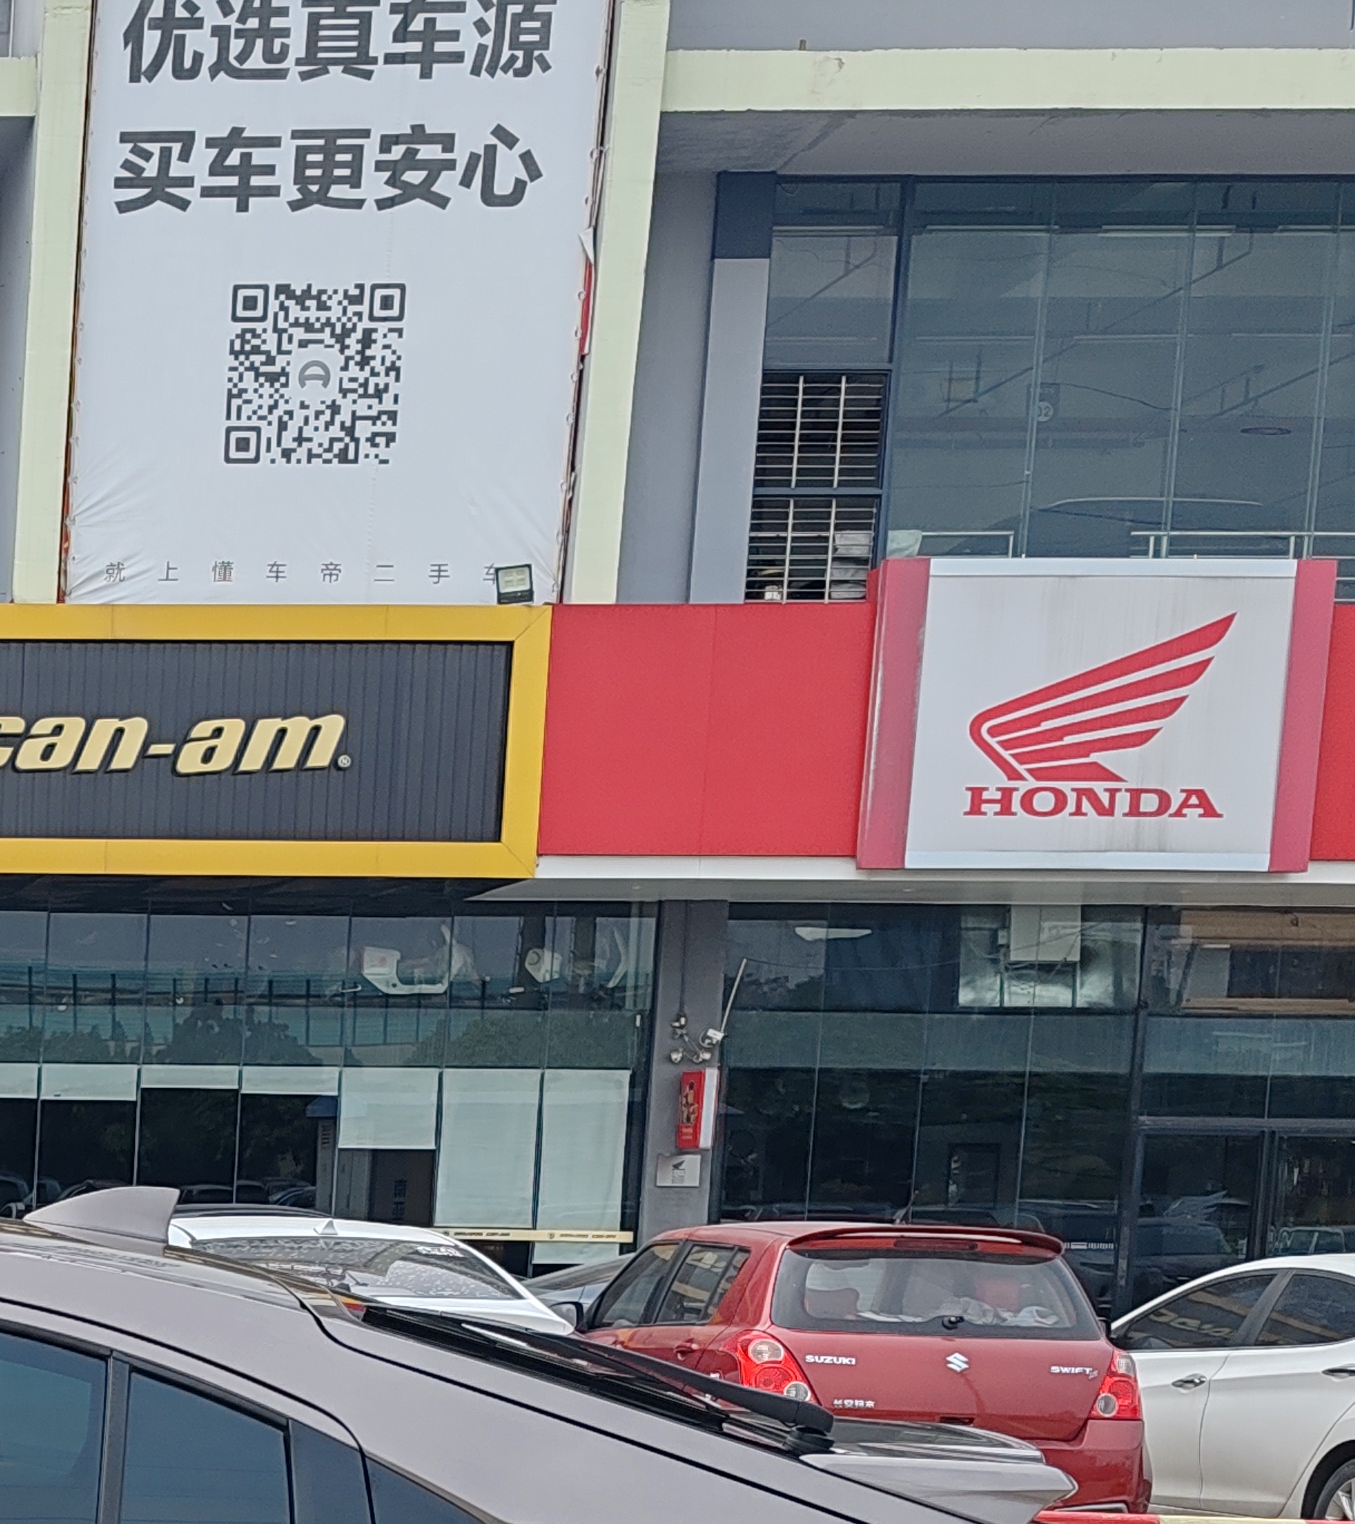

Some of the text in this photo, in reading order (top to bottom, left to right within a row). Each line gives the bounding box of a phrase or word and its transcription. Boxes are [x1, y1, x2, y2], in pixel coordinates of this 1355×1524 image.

[123, 0, 555, 83] 优选真车源
[114, 123, 543, 214] 买车更安心
[962, 786, 1225, 820] HONDA
[805, 1355, 856, 1365] SUZUKI
[1050, 1366, 1093, 1375] SWIFT
